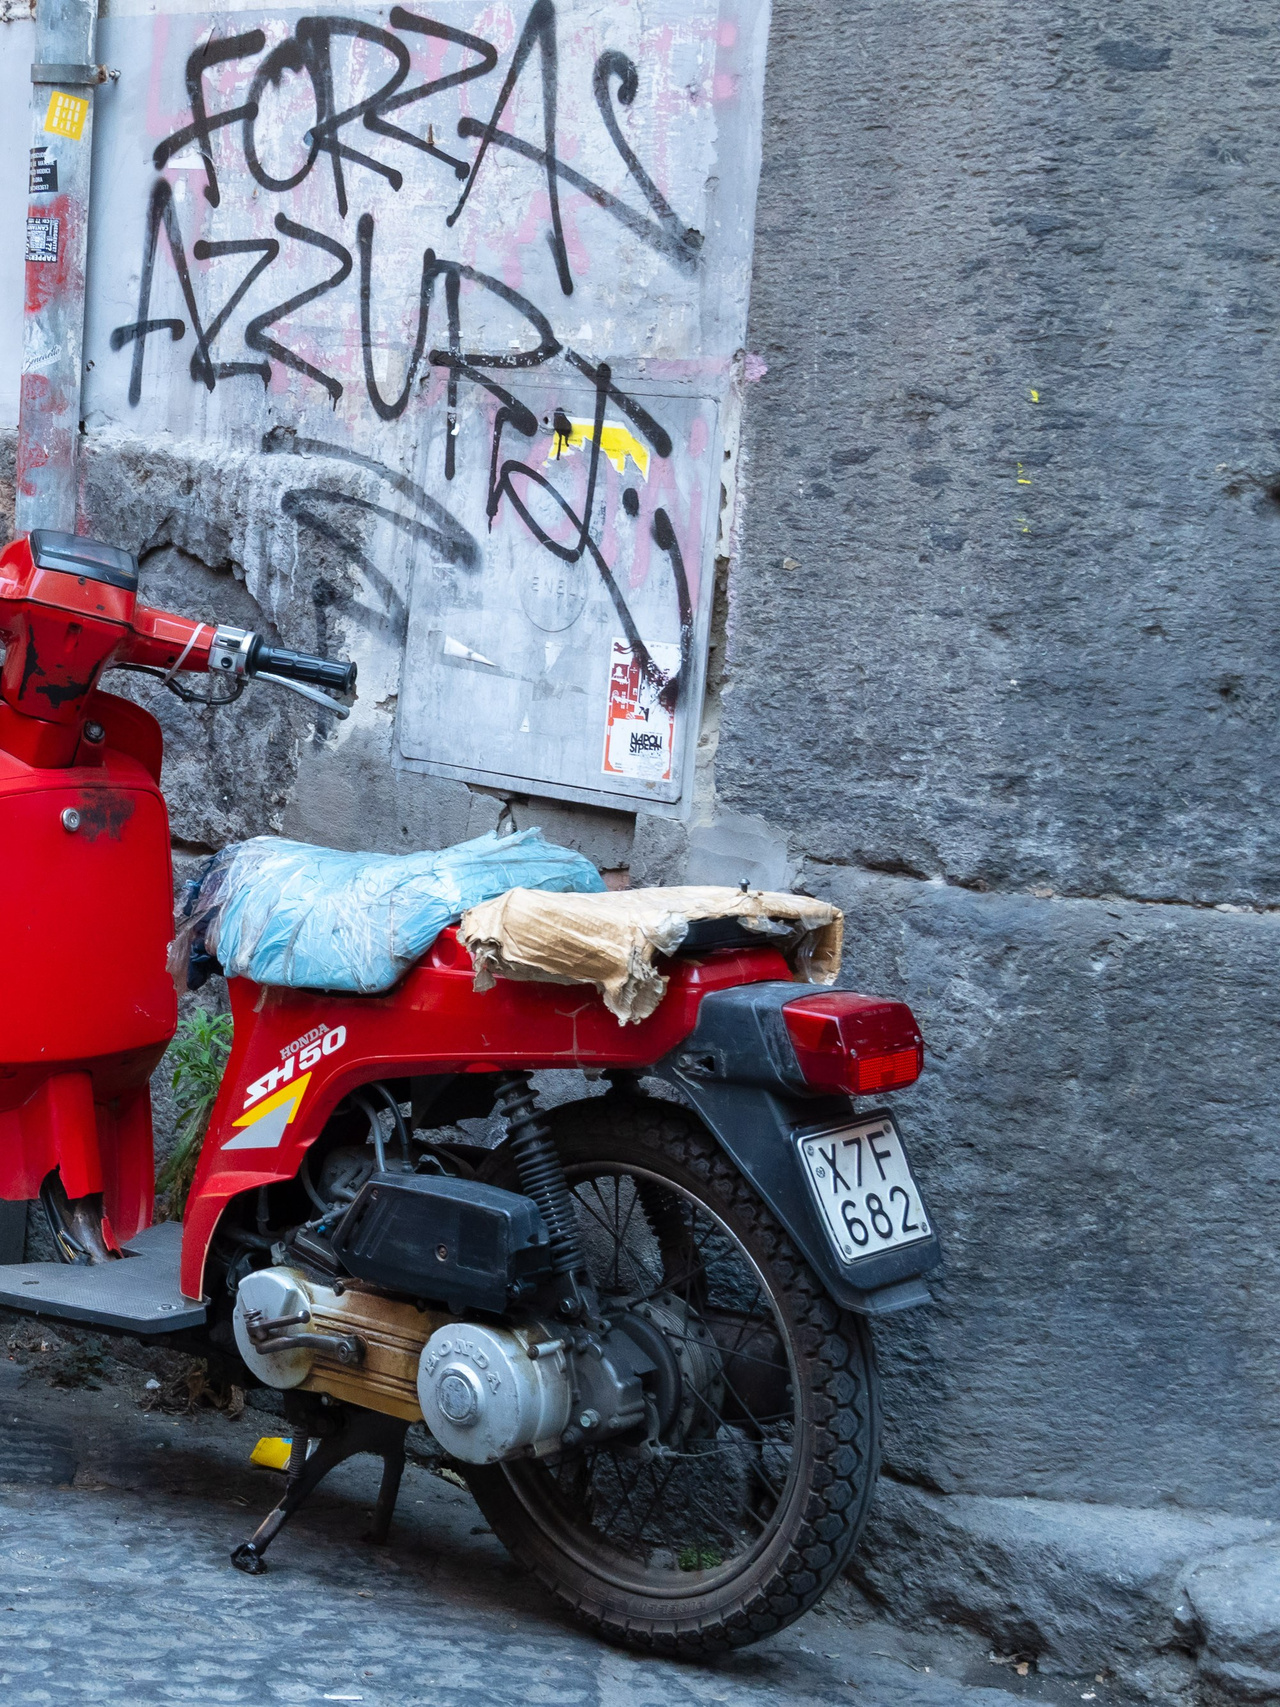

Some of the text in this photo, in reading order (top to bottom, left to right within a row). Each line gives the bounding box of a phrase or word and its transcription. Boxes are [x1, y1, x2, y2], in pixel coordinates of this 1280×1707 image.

[242, 1024, 347, 1110] SH 50
[279, 1022, 331, 1061] HONDA
[818, 1130, 892, 1194] X7F
[840, 1185, 920, 1247] 682
[424, 1337, 502, 1396] HONDA
